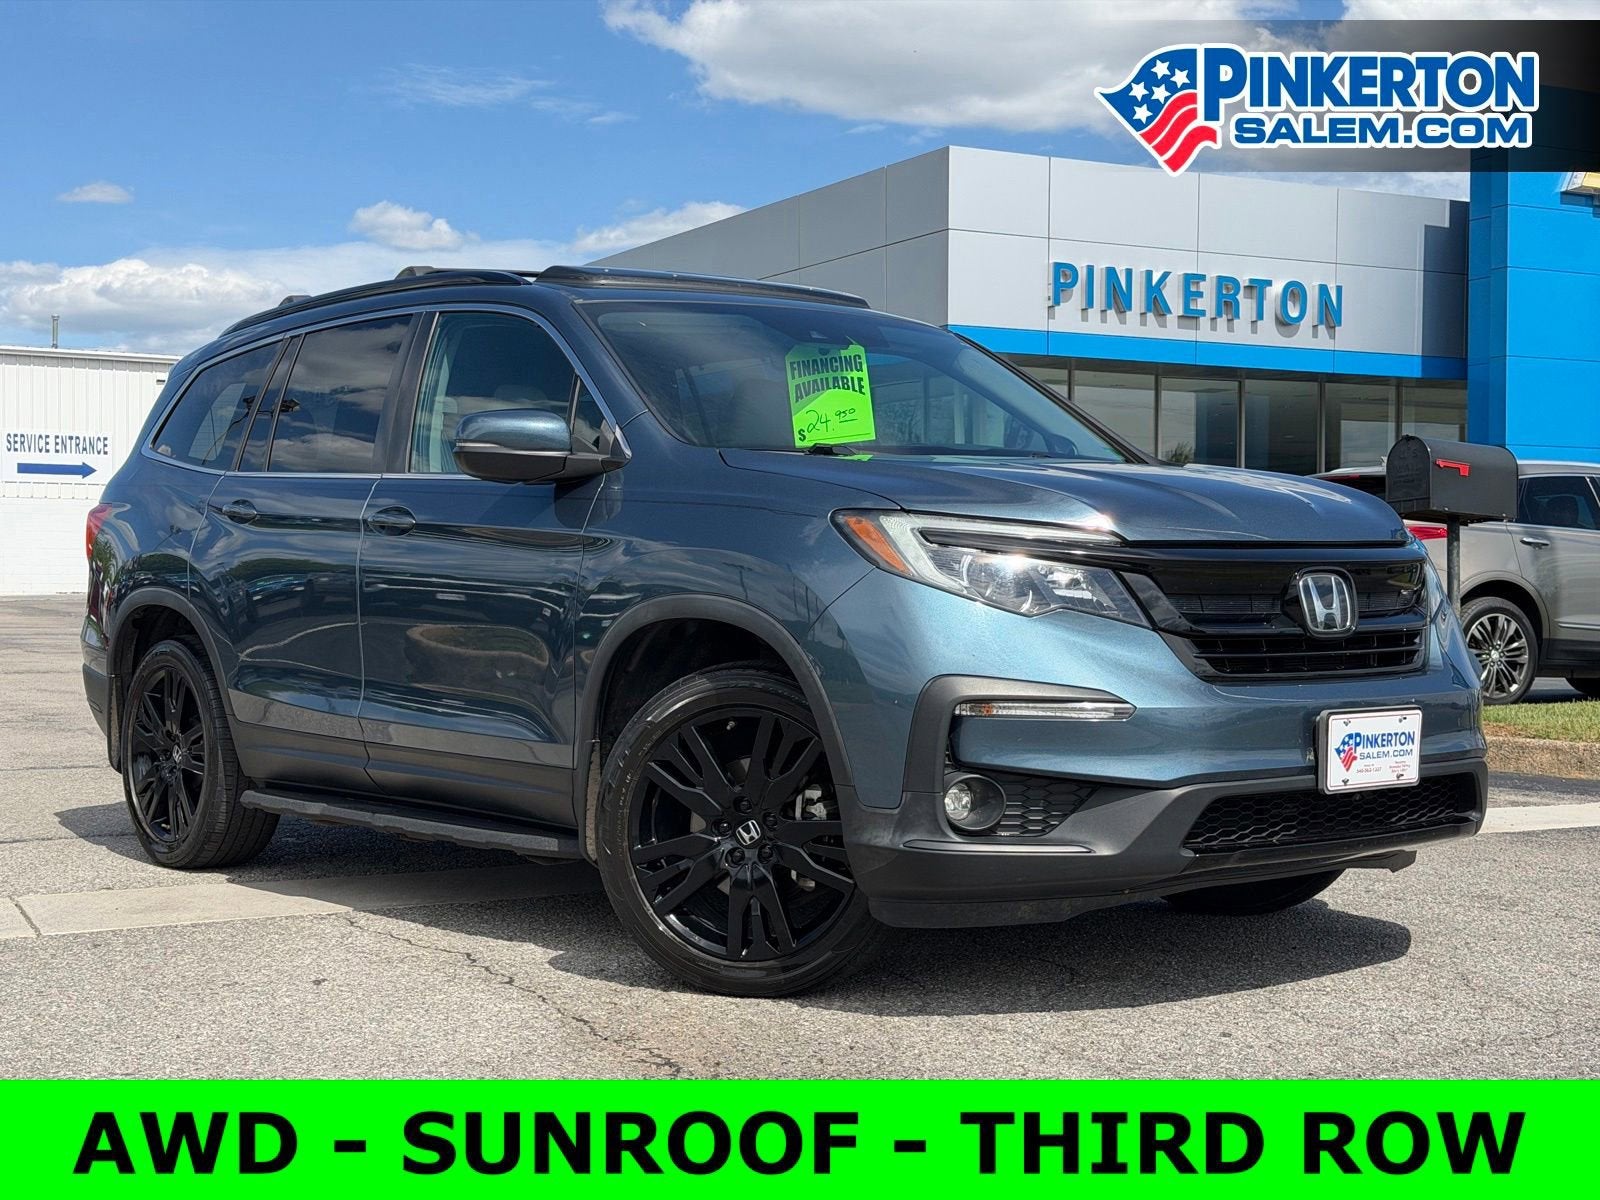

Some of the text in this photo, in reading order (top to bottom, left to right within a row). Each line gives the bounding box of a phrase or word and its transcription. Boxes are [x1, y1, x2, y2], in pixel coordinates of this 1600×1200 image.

[1051, 261, 1343, 328] PINKERTON
[789, 354, 864, 380] FINANCING
[795, 375, 866, 403] AVAILABLE
[6, 433, 108, 455] SERVICE ENTRANCE
[1354, 731, 1415, 754] PINKERTON
[1359, 749, 1413, 760] SALEM.COM
